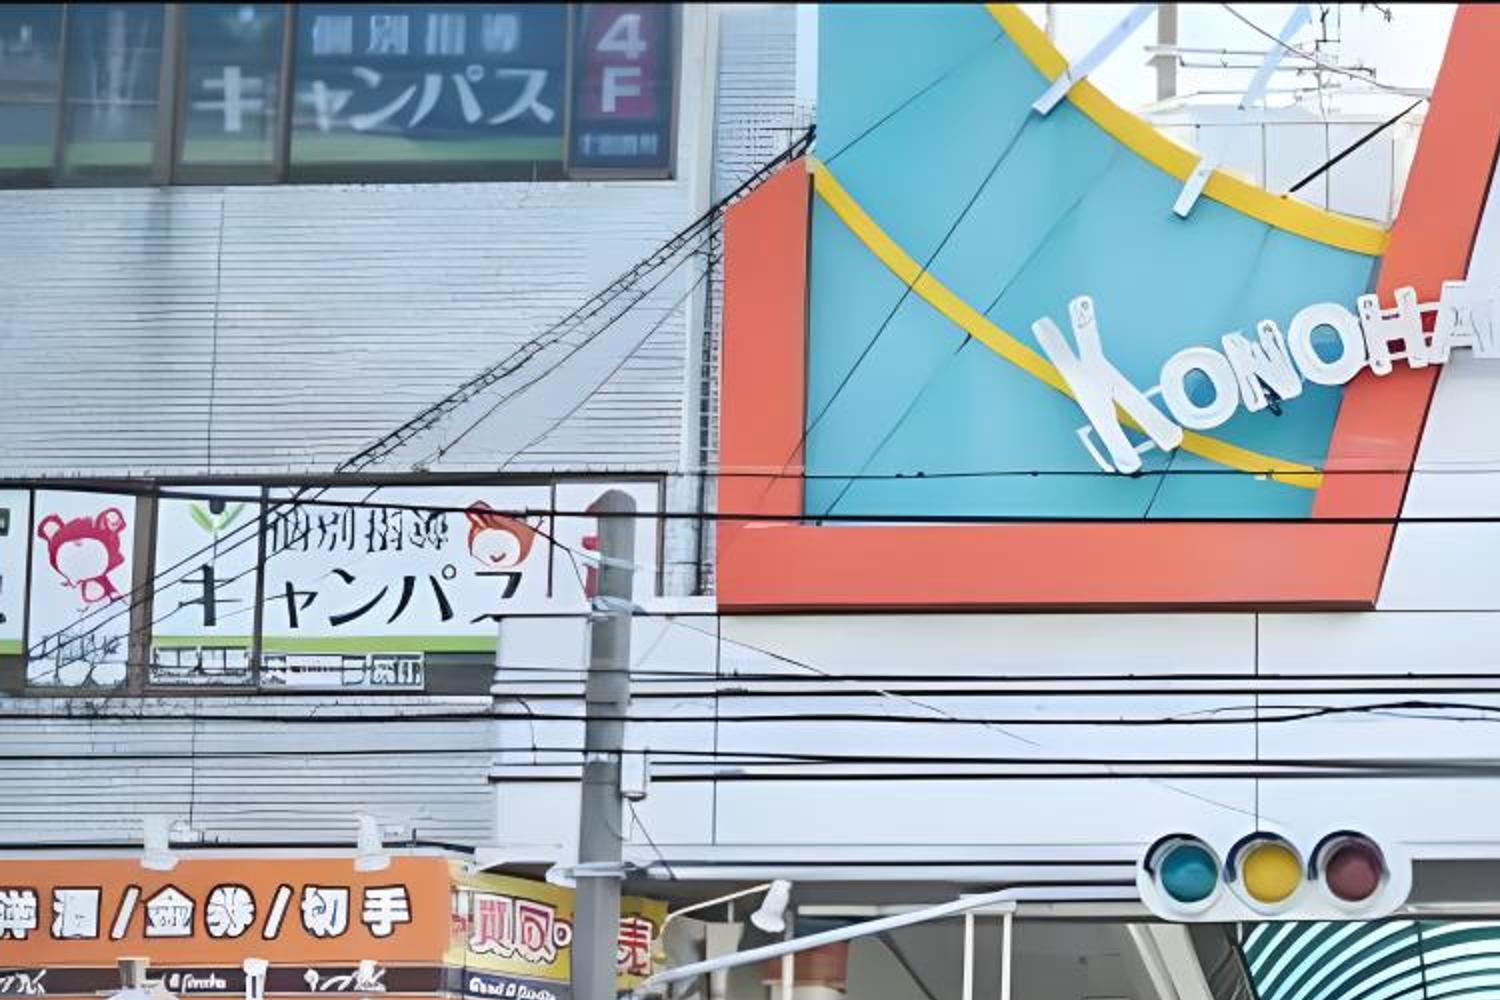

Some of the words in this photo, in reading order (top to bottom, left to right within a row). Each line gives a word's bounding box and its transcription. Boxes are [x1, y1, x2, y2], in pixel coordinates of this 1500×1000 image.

[192, 64, 555, 132] キャンパス
